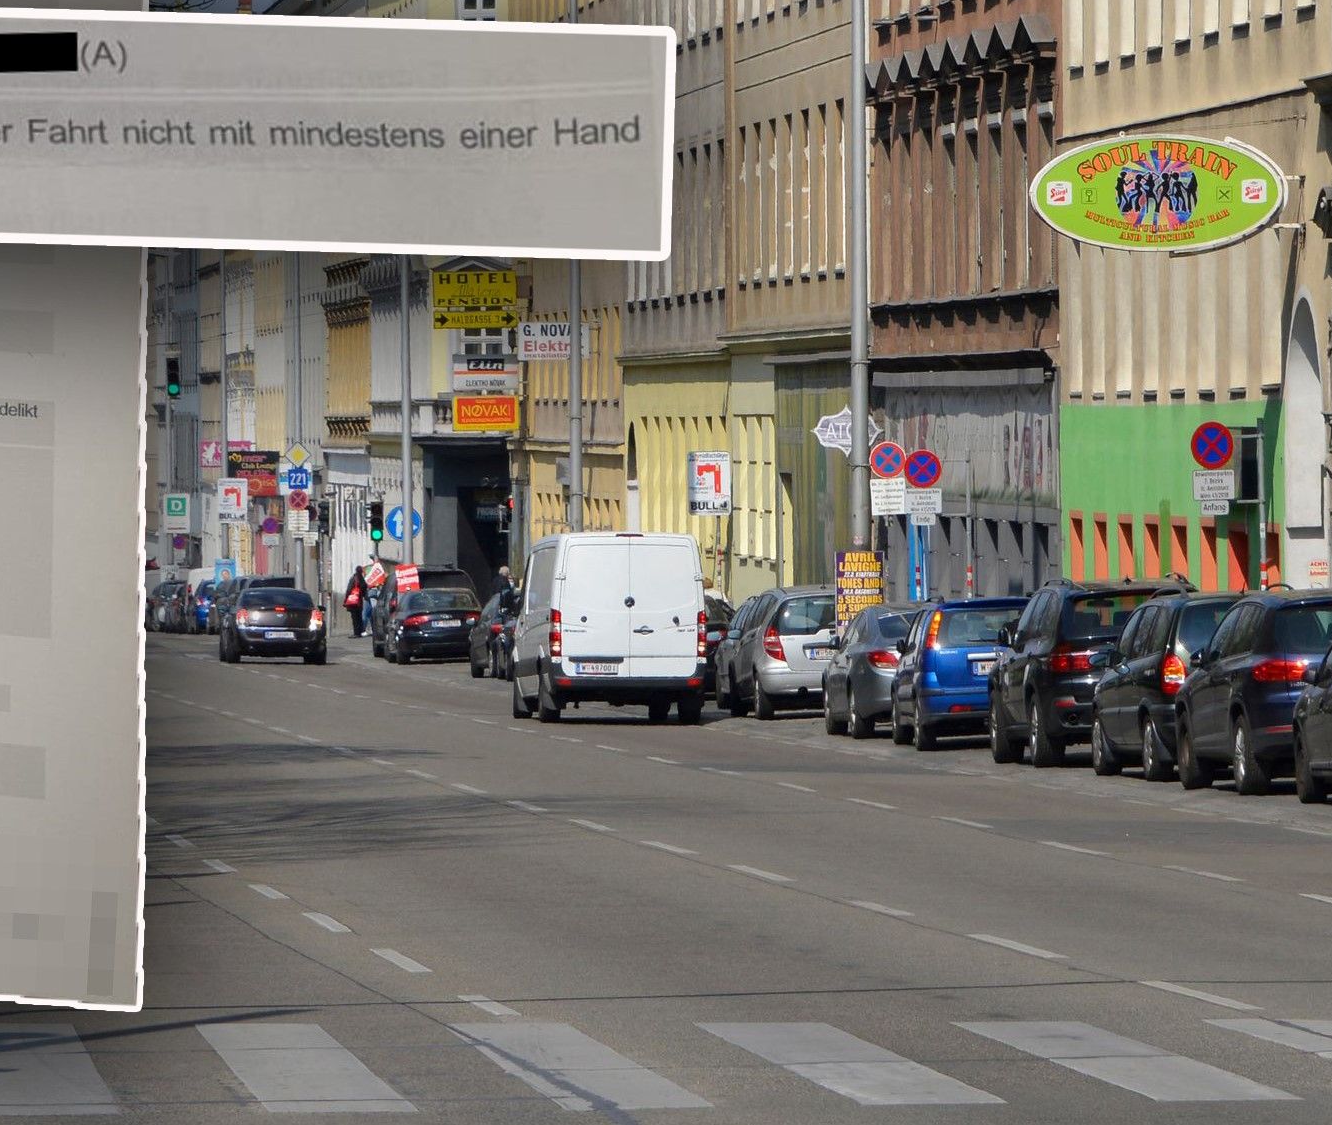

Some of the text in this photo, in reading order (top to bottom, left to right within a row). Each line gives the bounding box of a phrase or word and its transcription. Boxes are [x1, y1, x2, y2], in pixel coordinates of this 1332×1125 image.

[26, 117, 110, 146] Fahrt
[122, 118, 197, 146] nicht
[208, 118, 257, 147] mit
[268, 120, 447, 150] mindestens
[458, 120, 540, 150] einer
[553, 113, 642, 148] Hand
[1076, 140, 1238, 183] SOUL TRAIN
[1172, 216, 1206, 231] MUSIC
[1208, 209, 1229, 223] BAR
[1119, 232, 1195, 243] AND KITCHEN
[439, 273, 511, 284] HOTEL
[438, 297, 513, 305] PENSION
[495, 315, 500, 323] 3
[523, 325, 535, 337] G.
[461, 405, 507, 417] NOVAK
[290, 474, 306, 485] 221
[691, 501, 718, 510] BULL
[1203, 504, 1226, 513] Anfang
[845, 553, 876, 562] AVRIL
[839, 562, 881, 571] LAVIGNE
[838, 578, 862, 588] TONES
[864, 578, 879, 588] AND
[845, 595, 882, 604] SECONDS
